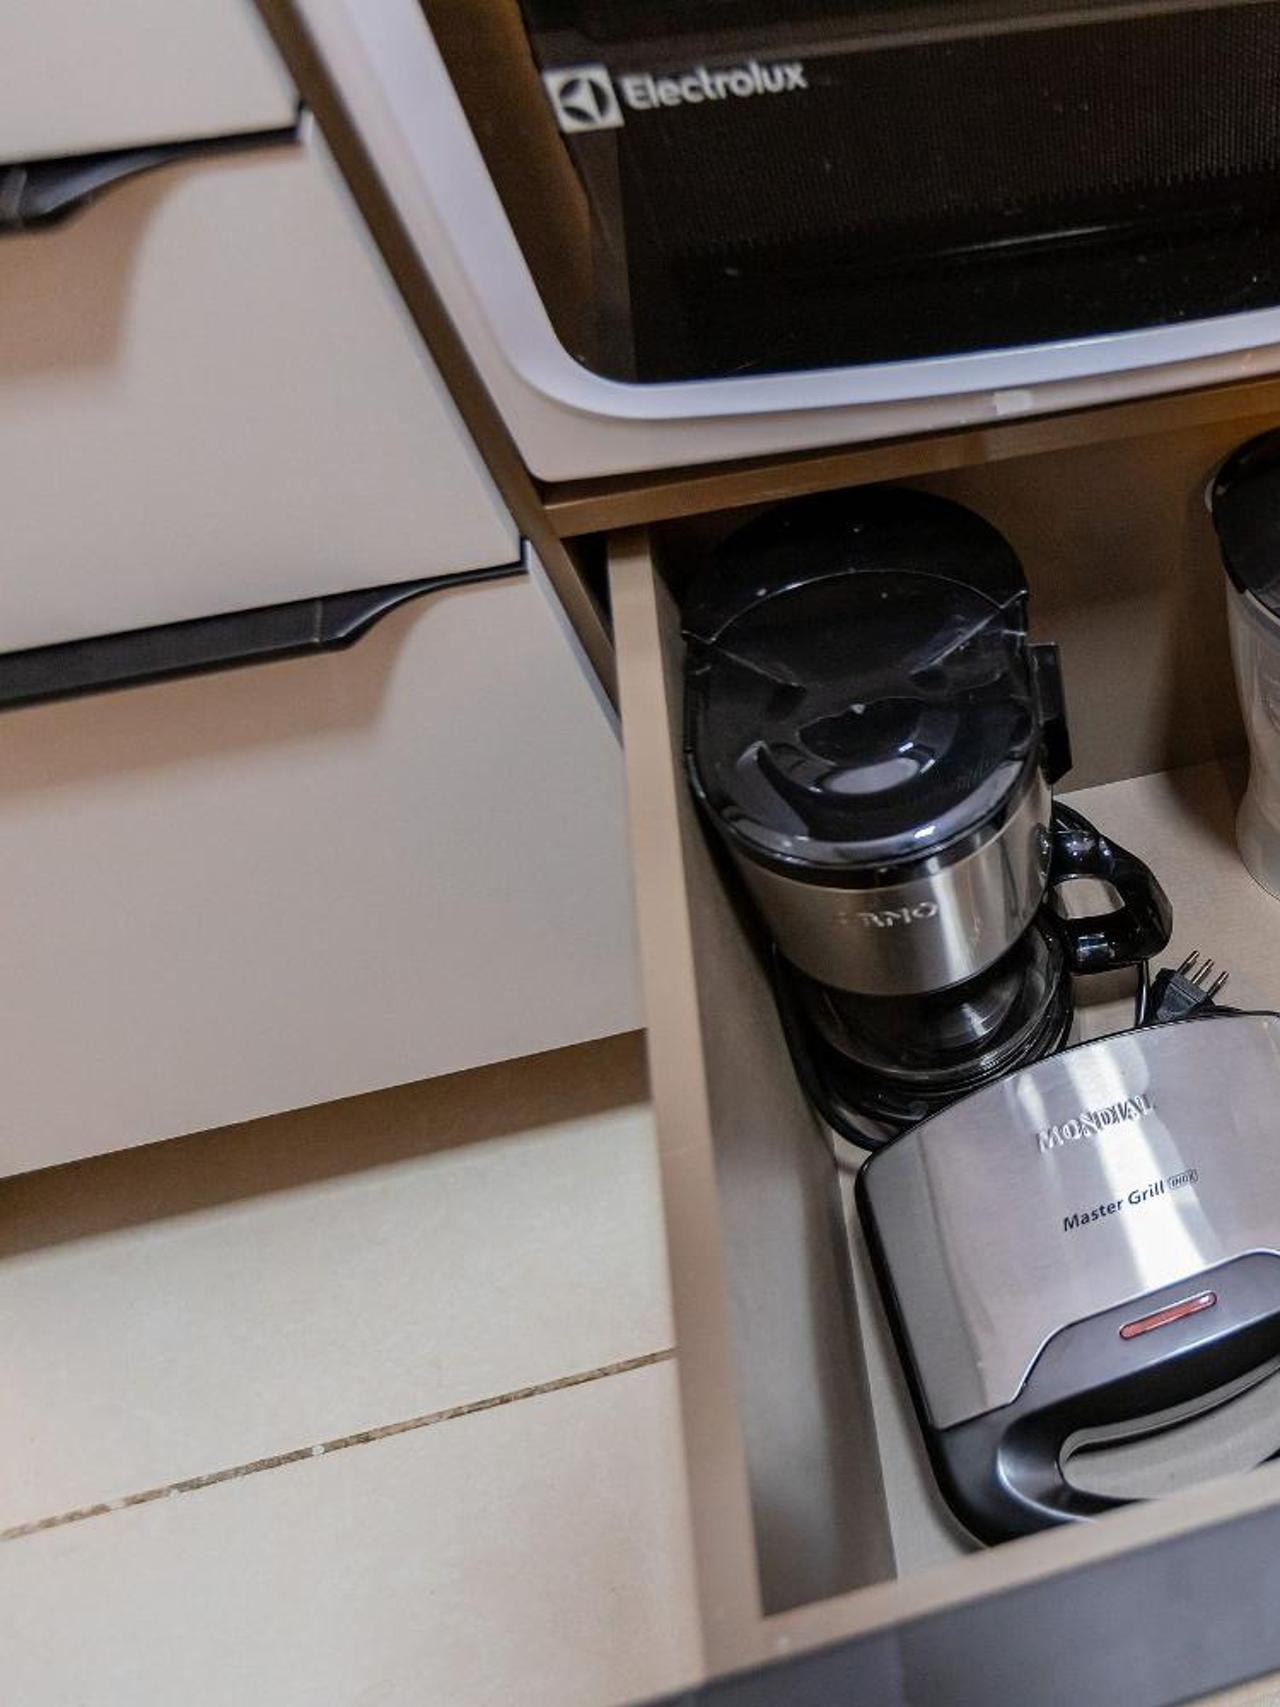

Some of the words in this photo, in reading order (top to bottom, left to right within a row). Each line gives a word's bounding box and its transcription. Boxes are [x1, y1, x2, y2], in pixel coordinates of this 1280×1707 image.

[620, 60, 808, 110] Electrolux
[1036, 1093, 1157, 1152] MONDIAL
[1063, 1199, 1124, 1232] Master
[1127, 1179, 1165, 1205] Grill
